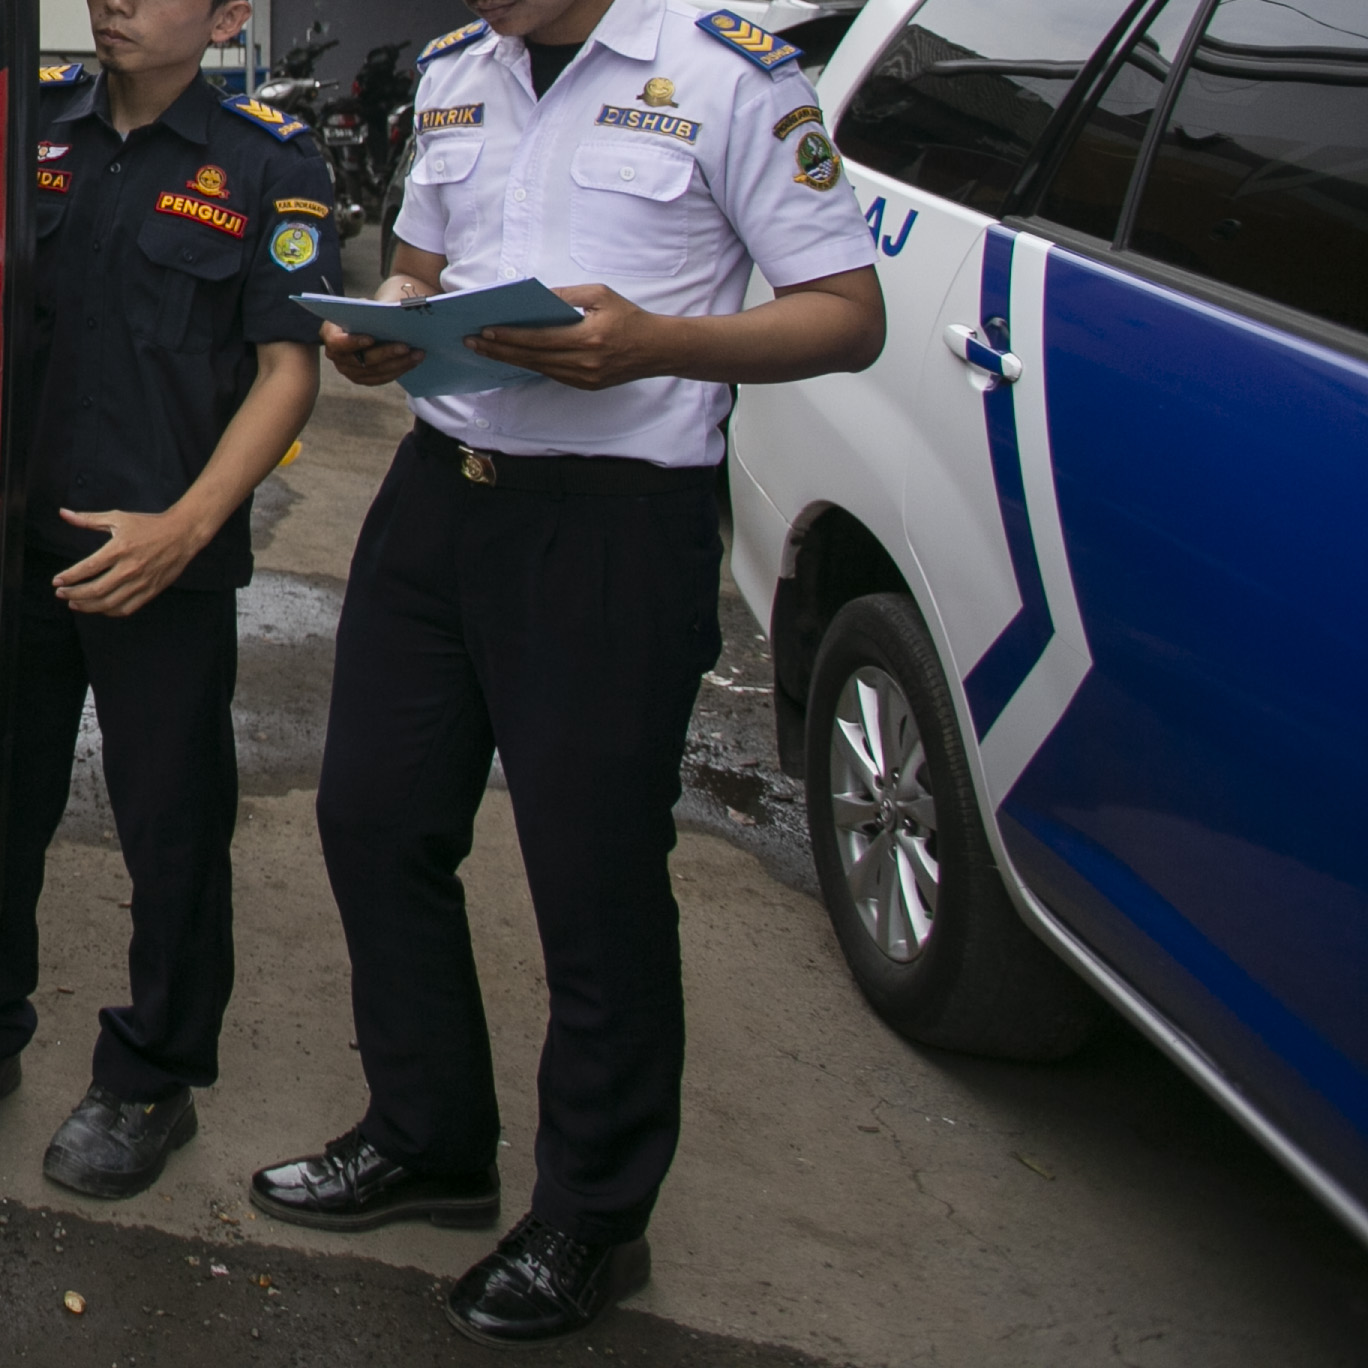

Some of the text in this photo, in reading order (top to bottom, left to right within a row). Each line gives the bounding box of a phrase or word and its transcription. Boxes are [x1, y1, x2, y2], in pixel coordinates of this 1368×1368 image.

[422, 107, 475, 128] RIKRIK
[605, 108, 693, 139] DISHUB
[160, 194, 242, 233] PENGUJI
[863, 195, 919, 257] AJ
